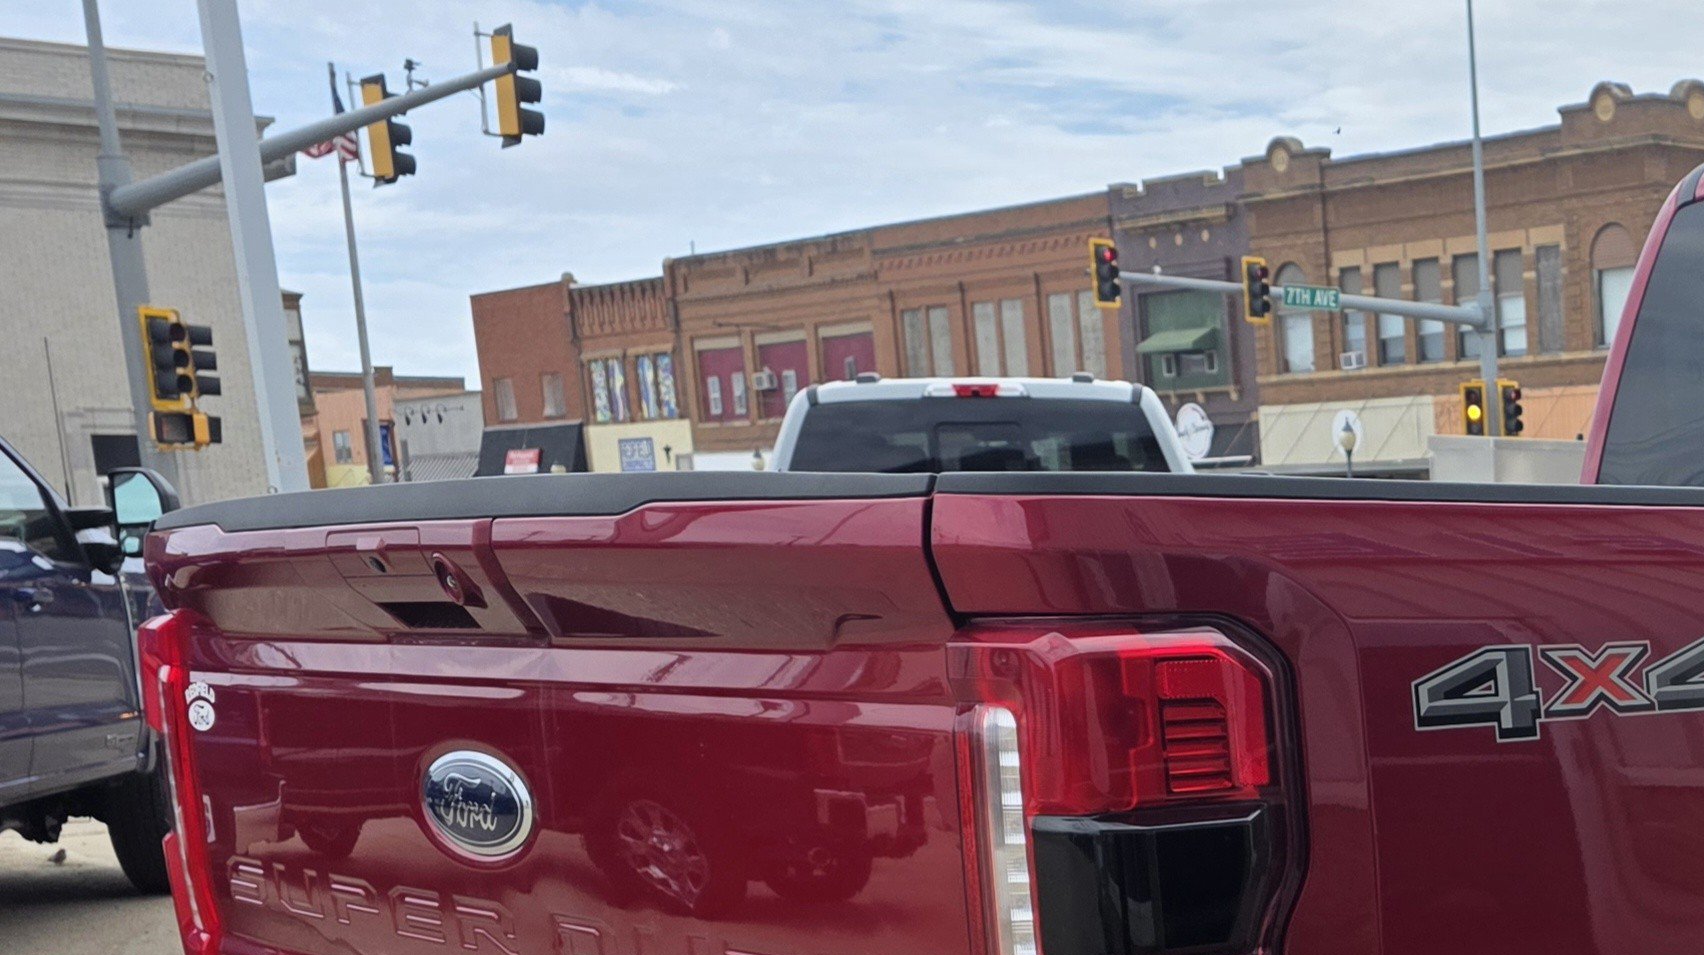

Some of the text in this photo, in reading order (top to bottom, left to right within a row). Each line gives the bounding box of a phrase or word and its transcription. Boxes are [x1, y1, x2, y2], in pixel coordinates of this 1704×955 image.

[1286, 286, 1337, 308] 7TH AVE
[440, 771, 498, 832] Ford
